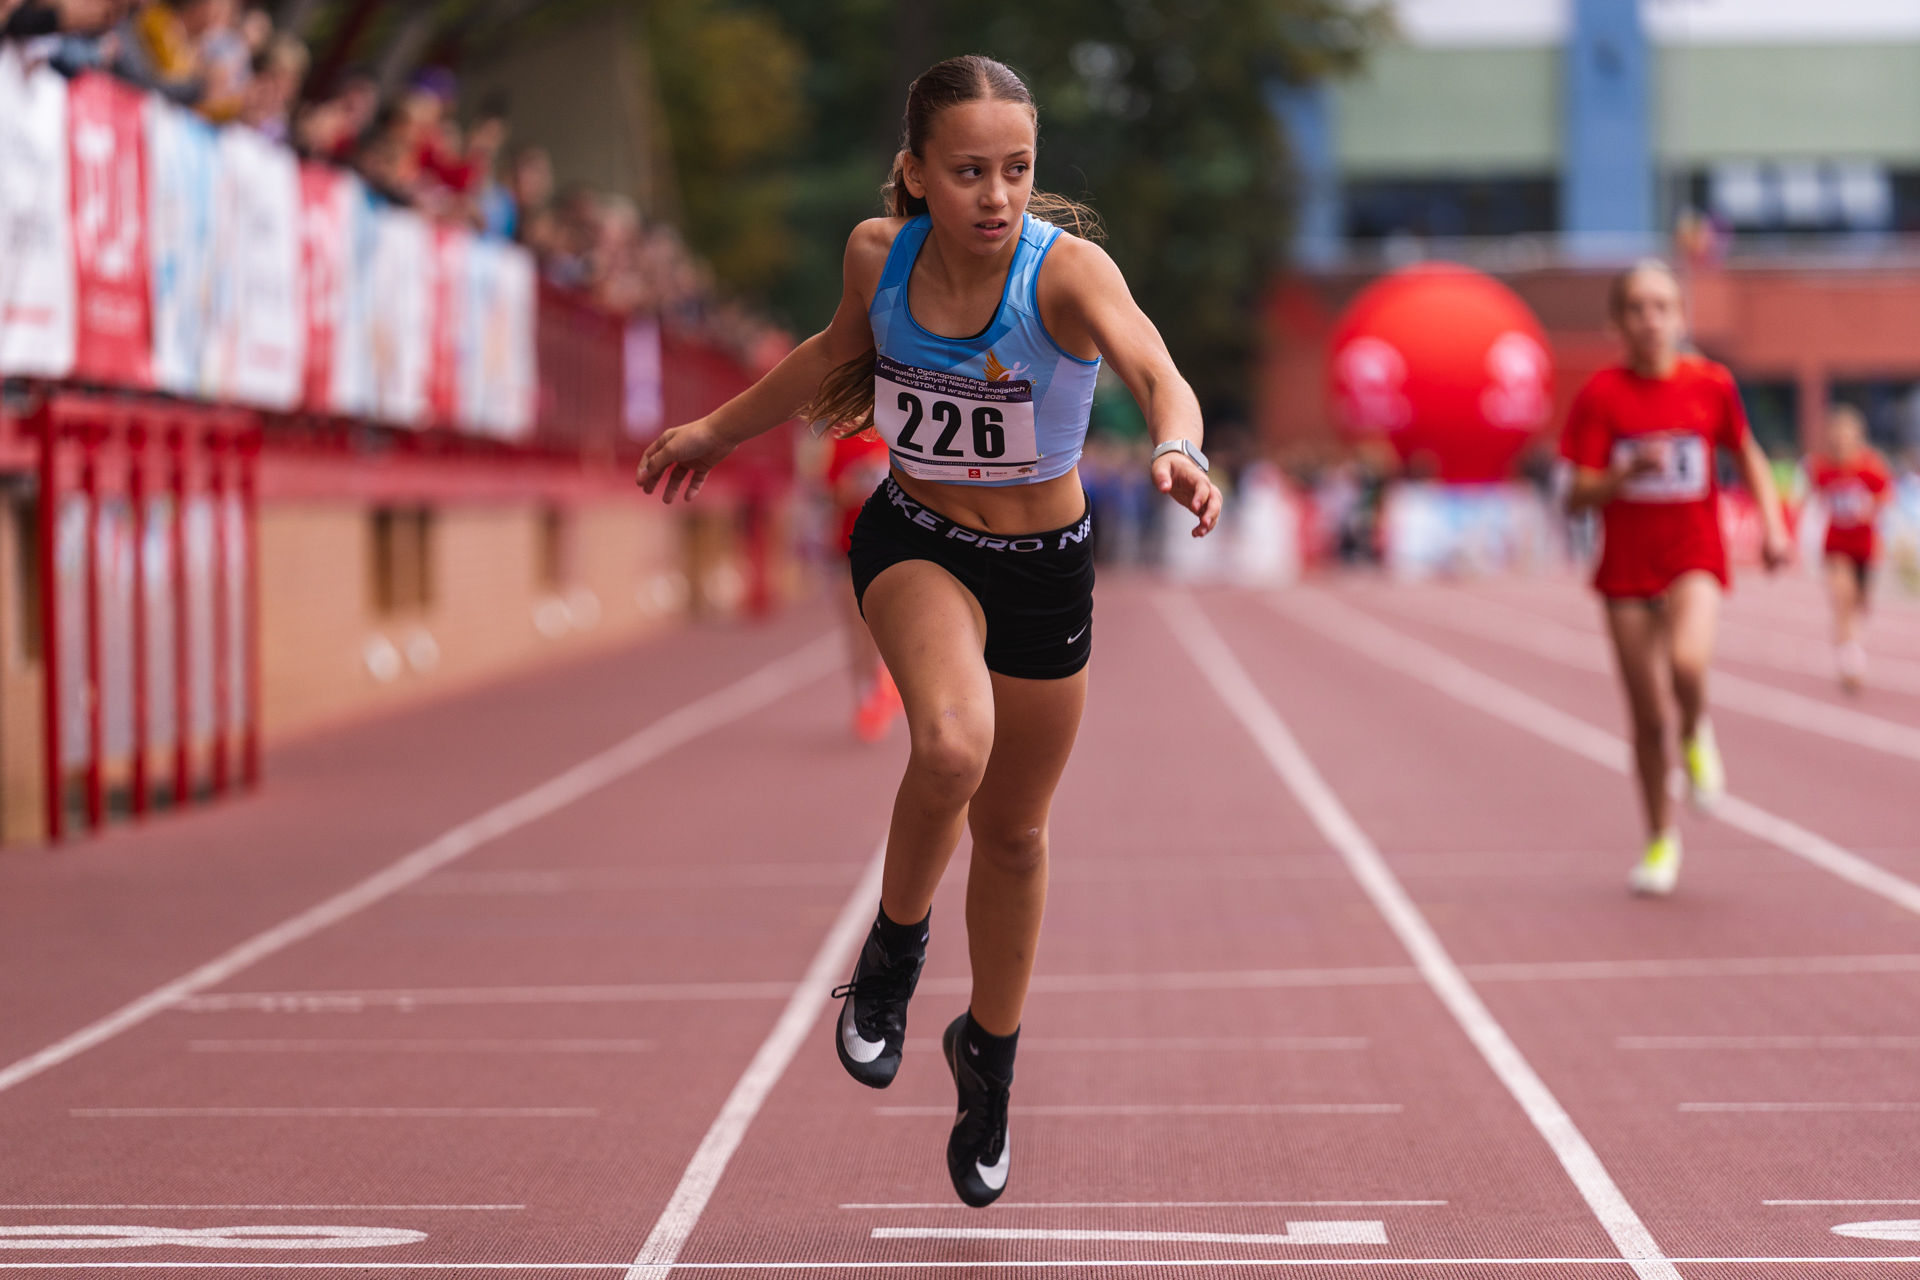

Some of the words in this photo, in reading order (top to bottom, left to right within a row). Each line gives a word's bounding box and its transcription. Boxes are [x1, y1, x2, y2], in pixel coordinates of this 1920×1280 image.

[880, 362, 947, 385] Lekkoatletycznych
[948, 380, 976, 391] Nadziei
[978, 386, 1026, 395] Olimpijskich
[917, 368, 968, 383] Ogólnopolski
[947, 387, 983, 399] września
[897, 392, 1005, 459] 226
[945, 526, 1044, 552] PRO
